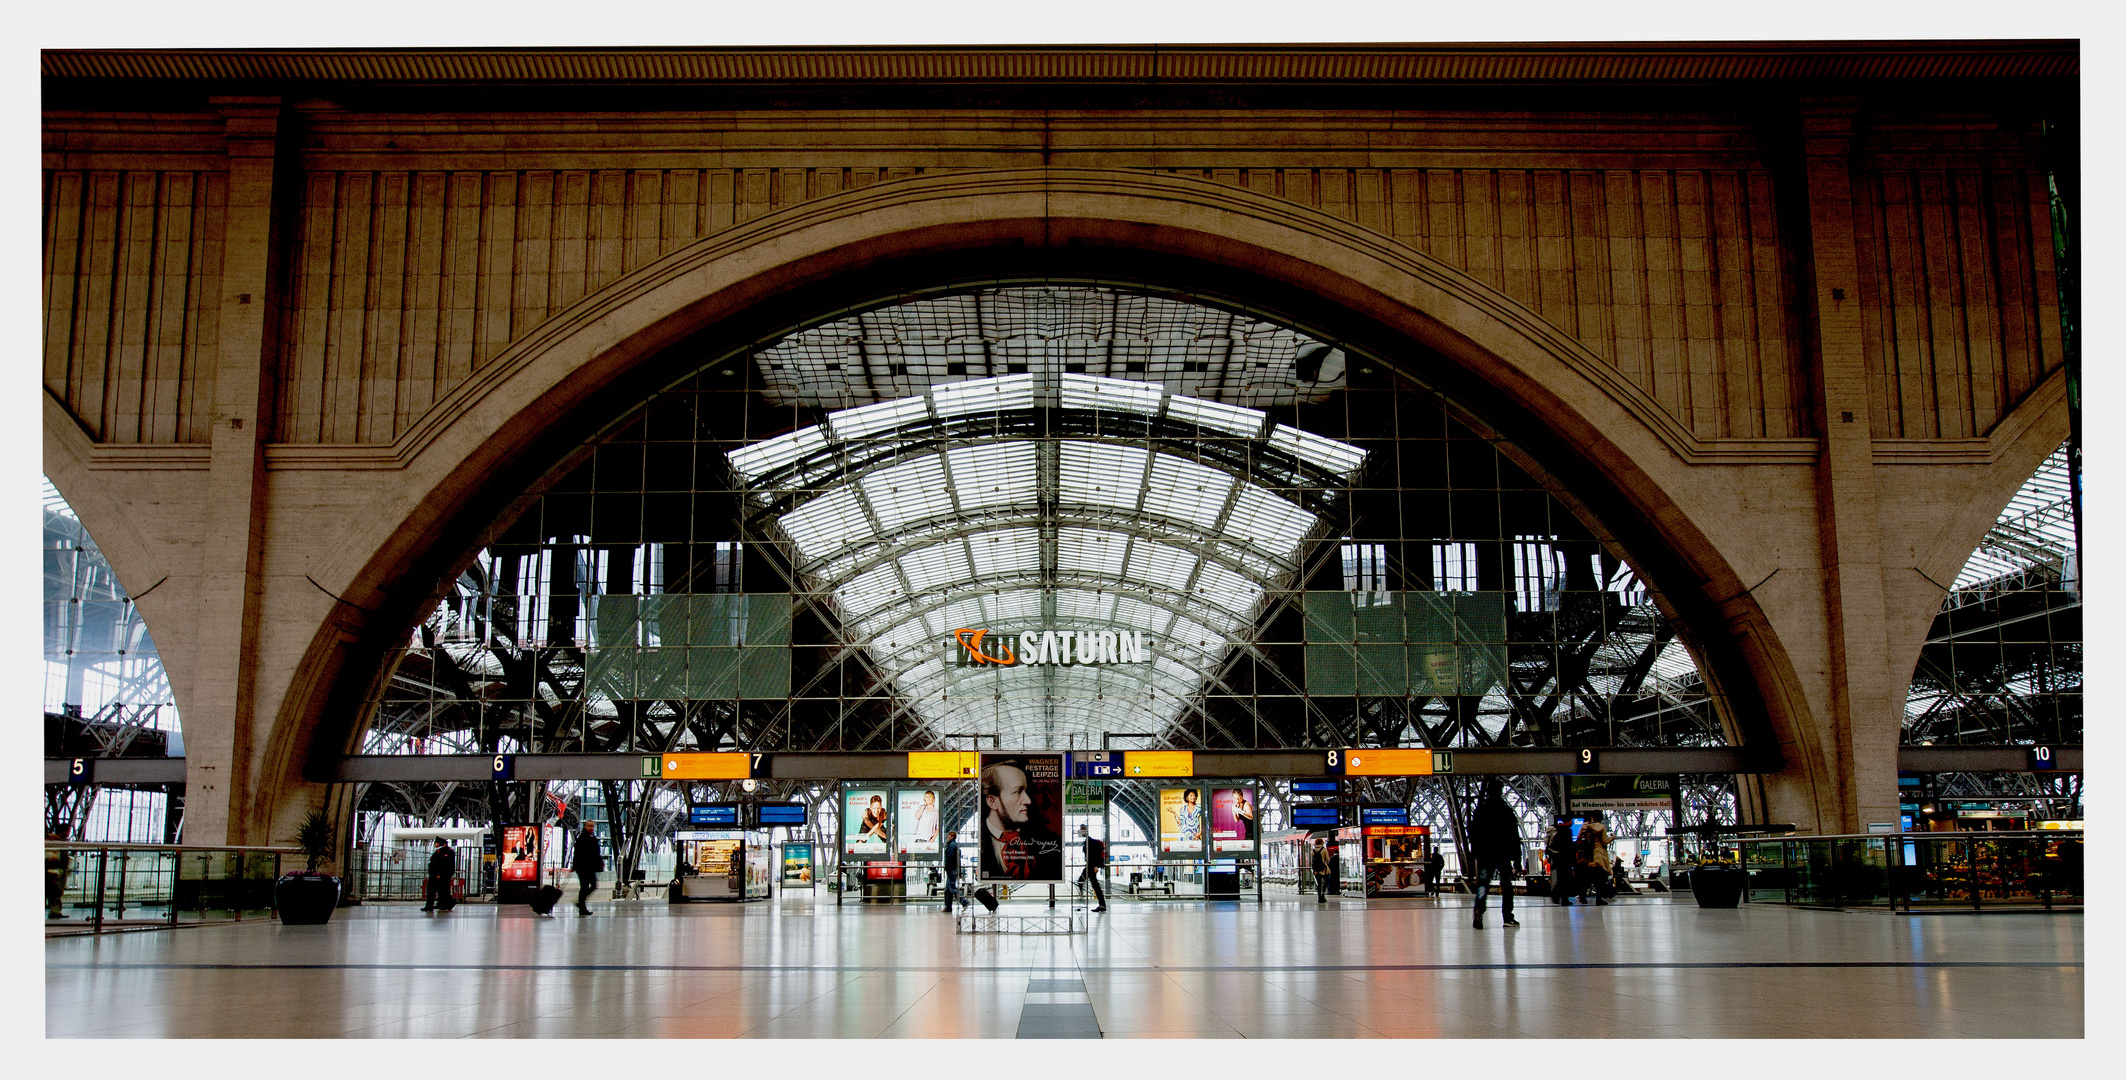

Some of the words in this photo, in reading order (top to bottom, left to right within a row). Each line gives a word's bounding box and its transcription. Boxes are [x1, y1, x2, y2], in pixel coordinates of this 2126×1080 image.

[1020, 630, 1142, 664] SATURN
[753, 753, 762, 769] 7
[1328, 750, 1338, 766] 8
[1582, 749, 1591, 763] 9
[2033, 746, 2050, 761] 10
[72, 758, 83, 774] 5
[494, 755, 504, 771] 6
[1073, 786, 1103, 795] GALERIA
[1640, 780, 1670, 789] GALERIA
